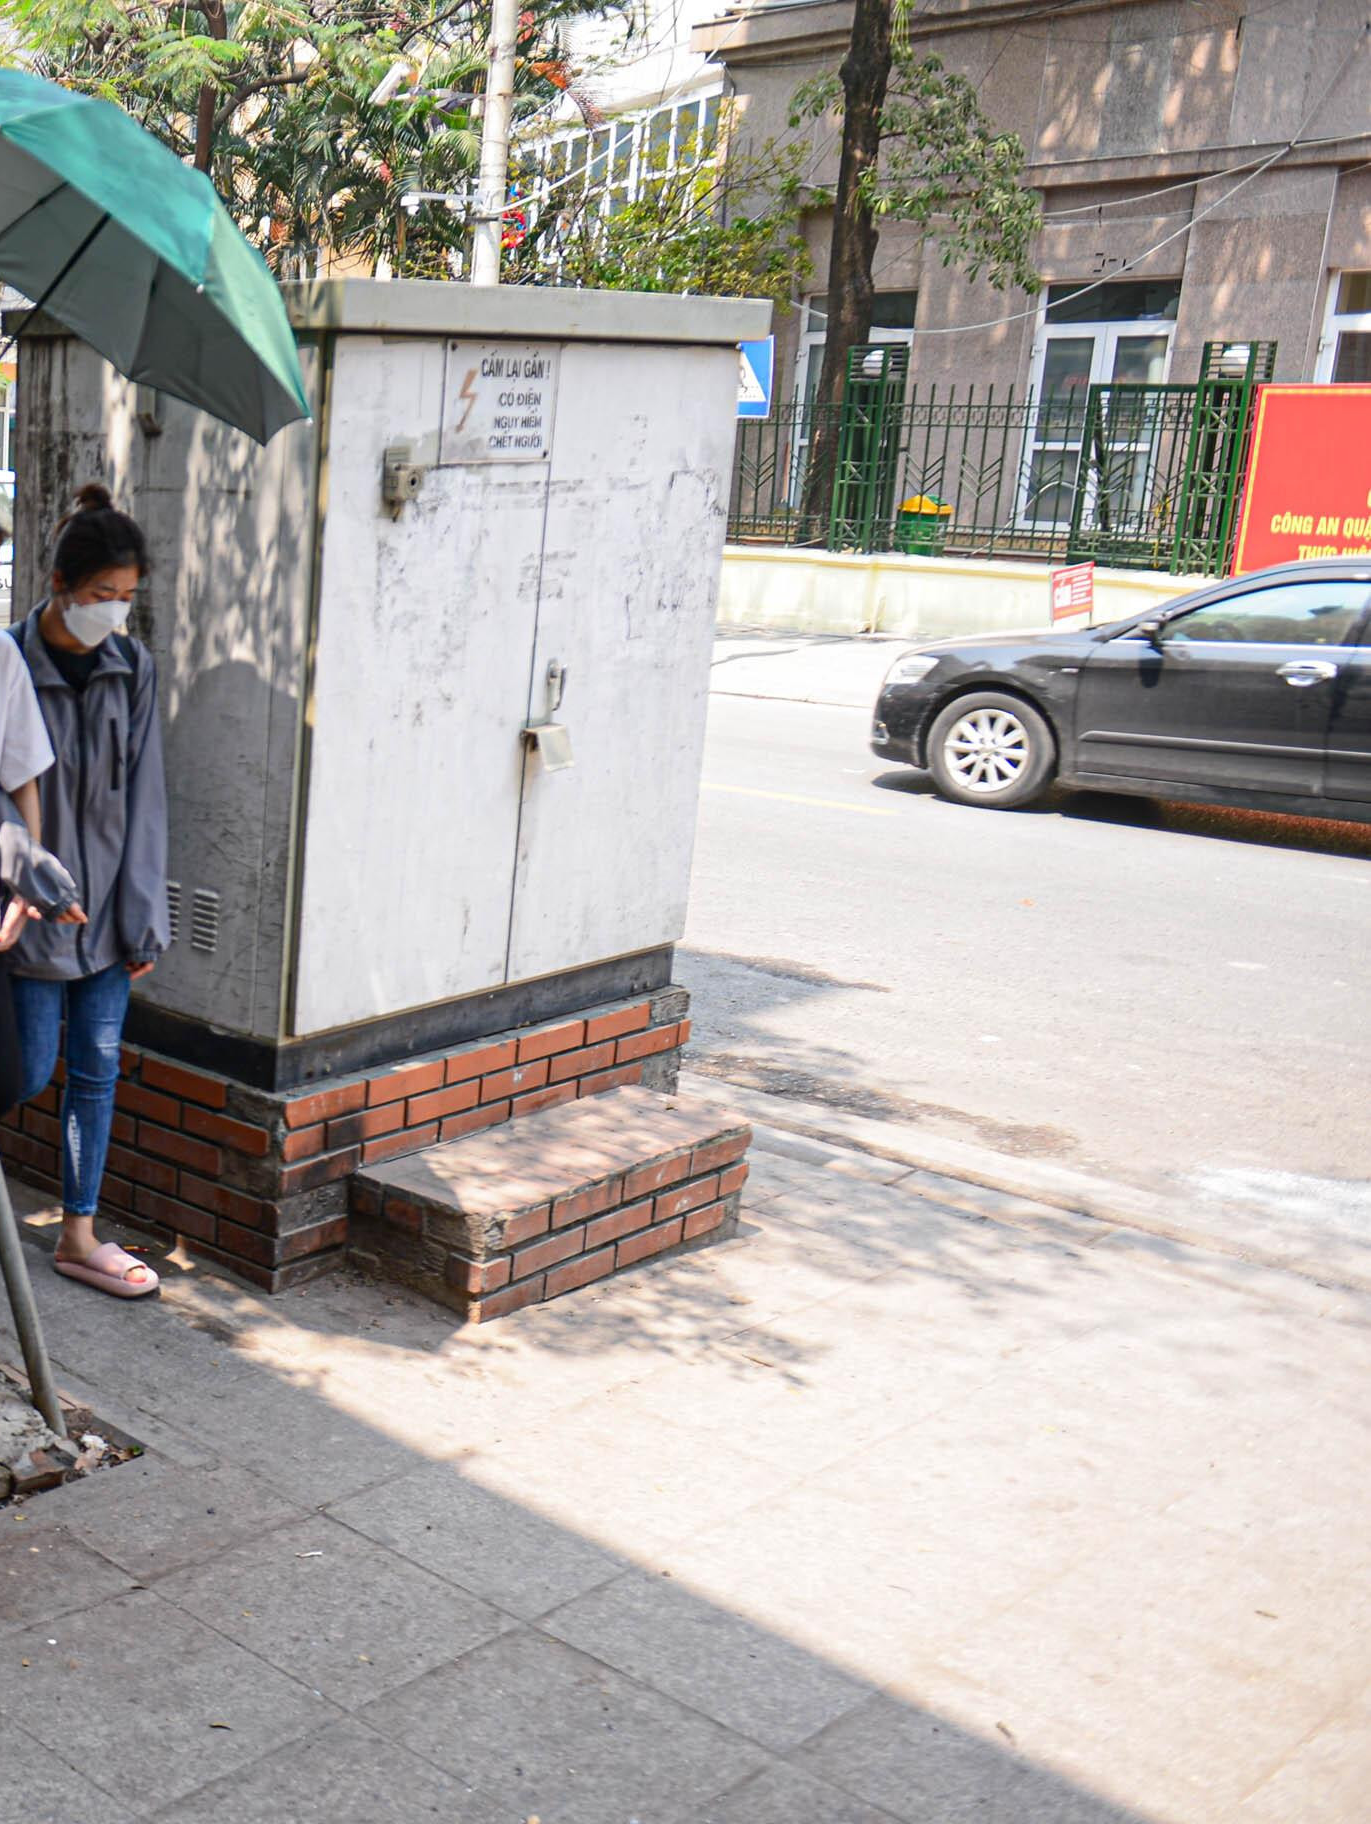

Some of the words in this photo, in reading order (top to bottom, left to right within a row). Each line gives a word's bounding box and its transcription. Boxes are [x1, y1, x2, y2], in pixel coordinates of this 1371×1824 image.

[481, 349, 504, 378] CẤM
[506, 360, 522, 383] LẠI
[524, 351, 545, 379] GẦN
[499, 387, 515, 407] CÓ
[517, 387, 542, 409] ĐIỆN
[494, 415, 519, 430] NGUY
[521, 407, 542, 428] HIỂM
[489, 429, 513, 448] CHẾT
[514, 431, 542, 448] NGƯỜI
[1270, 510, 1314, 534] CÔNG
[1315, 516, 1340, 536] AN
